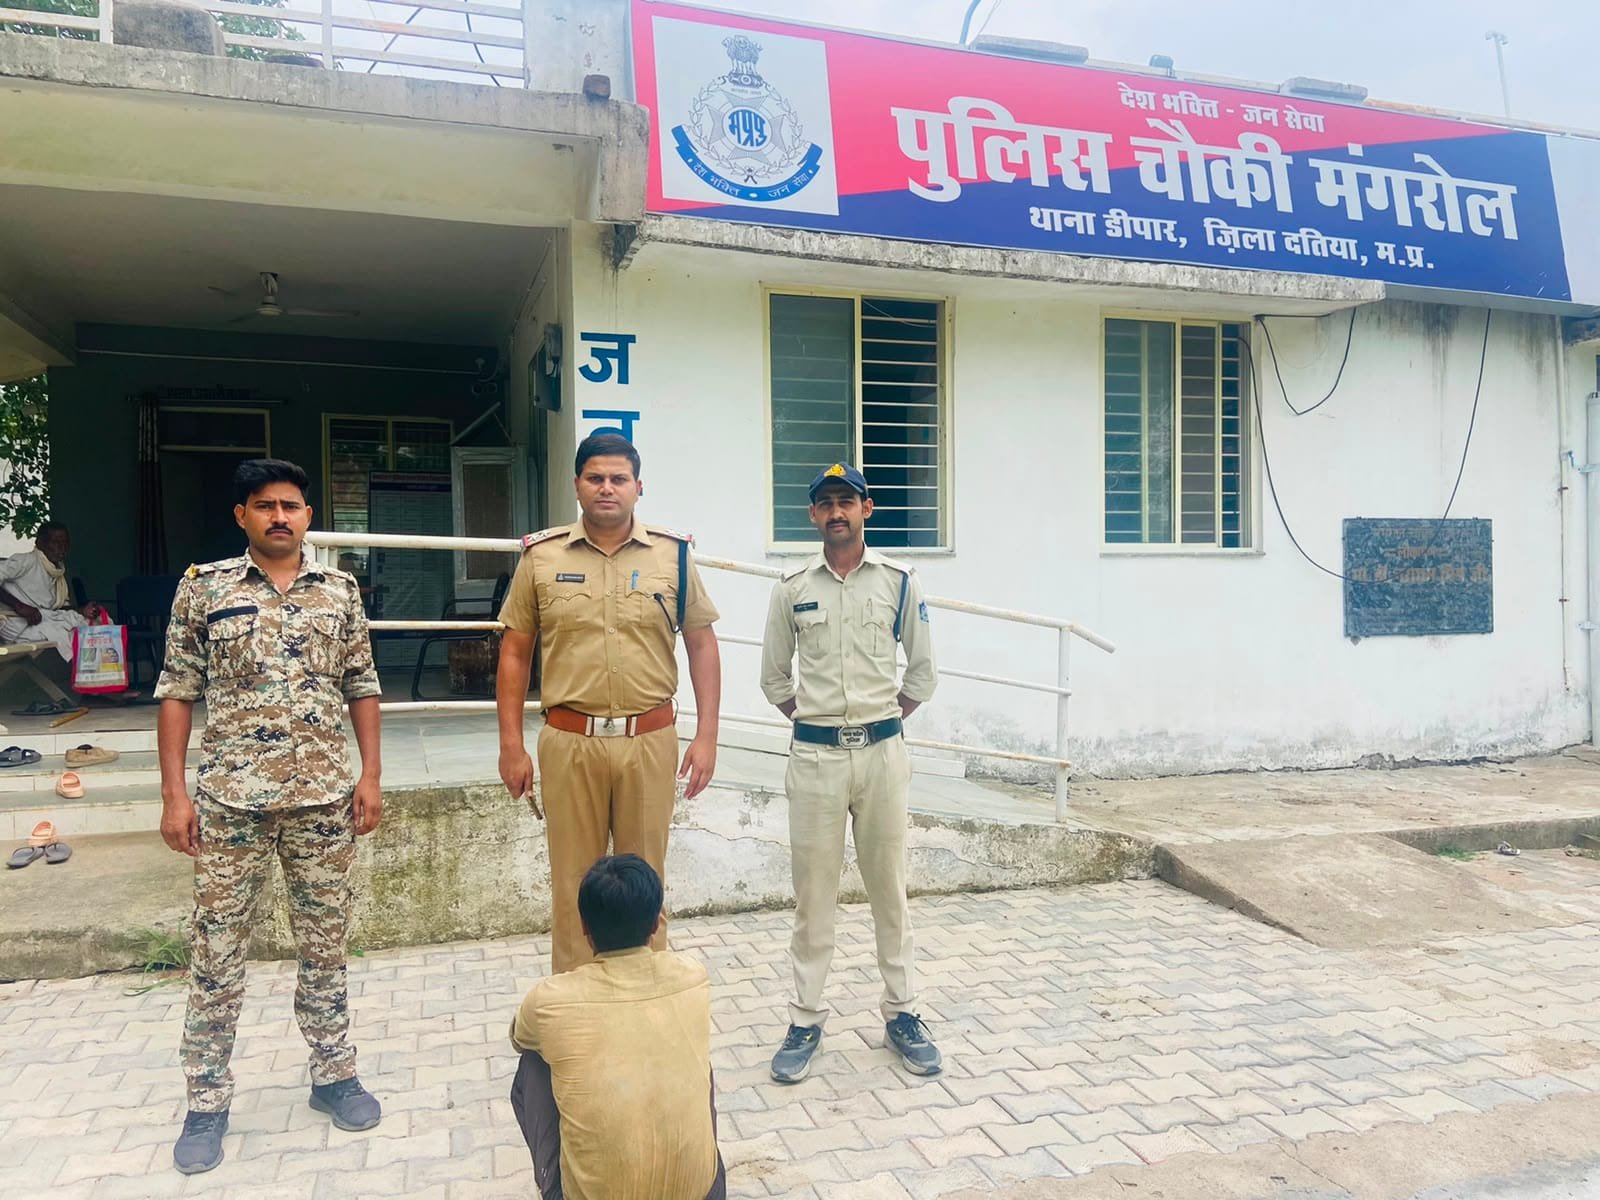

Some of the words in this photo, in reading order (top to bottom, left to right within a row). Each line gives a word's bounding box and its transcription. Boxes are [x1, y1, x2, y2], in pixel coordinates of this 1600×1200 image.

[1117, 81, 1156, 111] देश
[1162, 90, 1219, 119] भक्ति
[1240, 103, 1279, 127] जन
[1284, 104, 1325, 133] सेवा
[768, 185, 791, 198] जन
[890, 95, 1113, 203] पुलिस
[1129, 118, 1294, 213] चौकी
[1308, 142, 1519, 241] मंगरोल
[1029, 206, 1097, 235] थाना
[1102, 208, 1188, 249] डीपार,
[1281, 227, 1369, 266] दतिया,
[1374, 241, 1434, 269] म.प्र.
